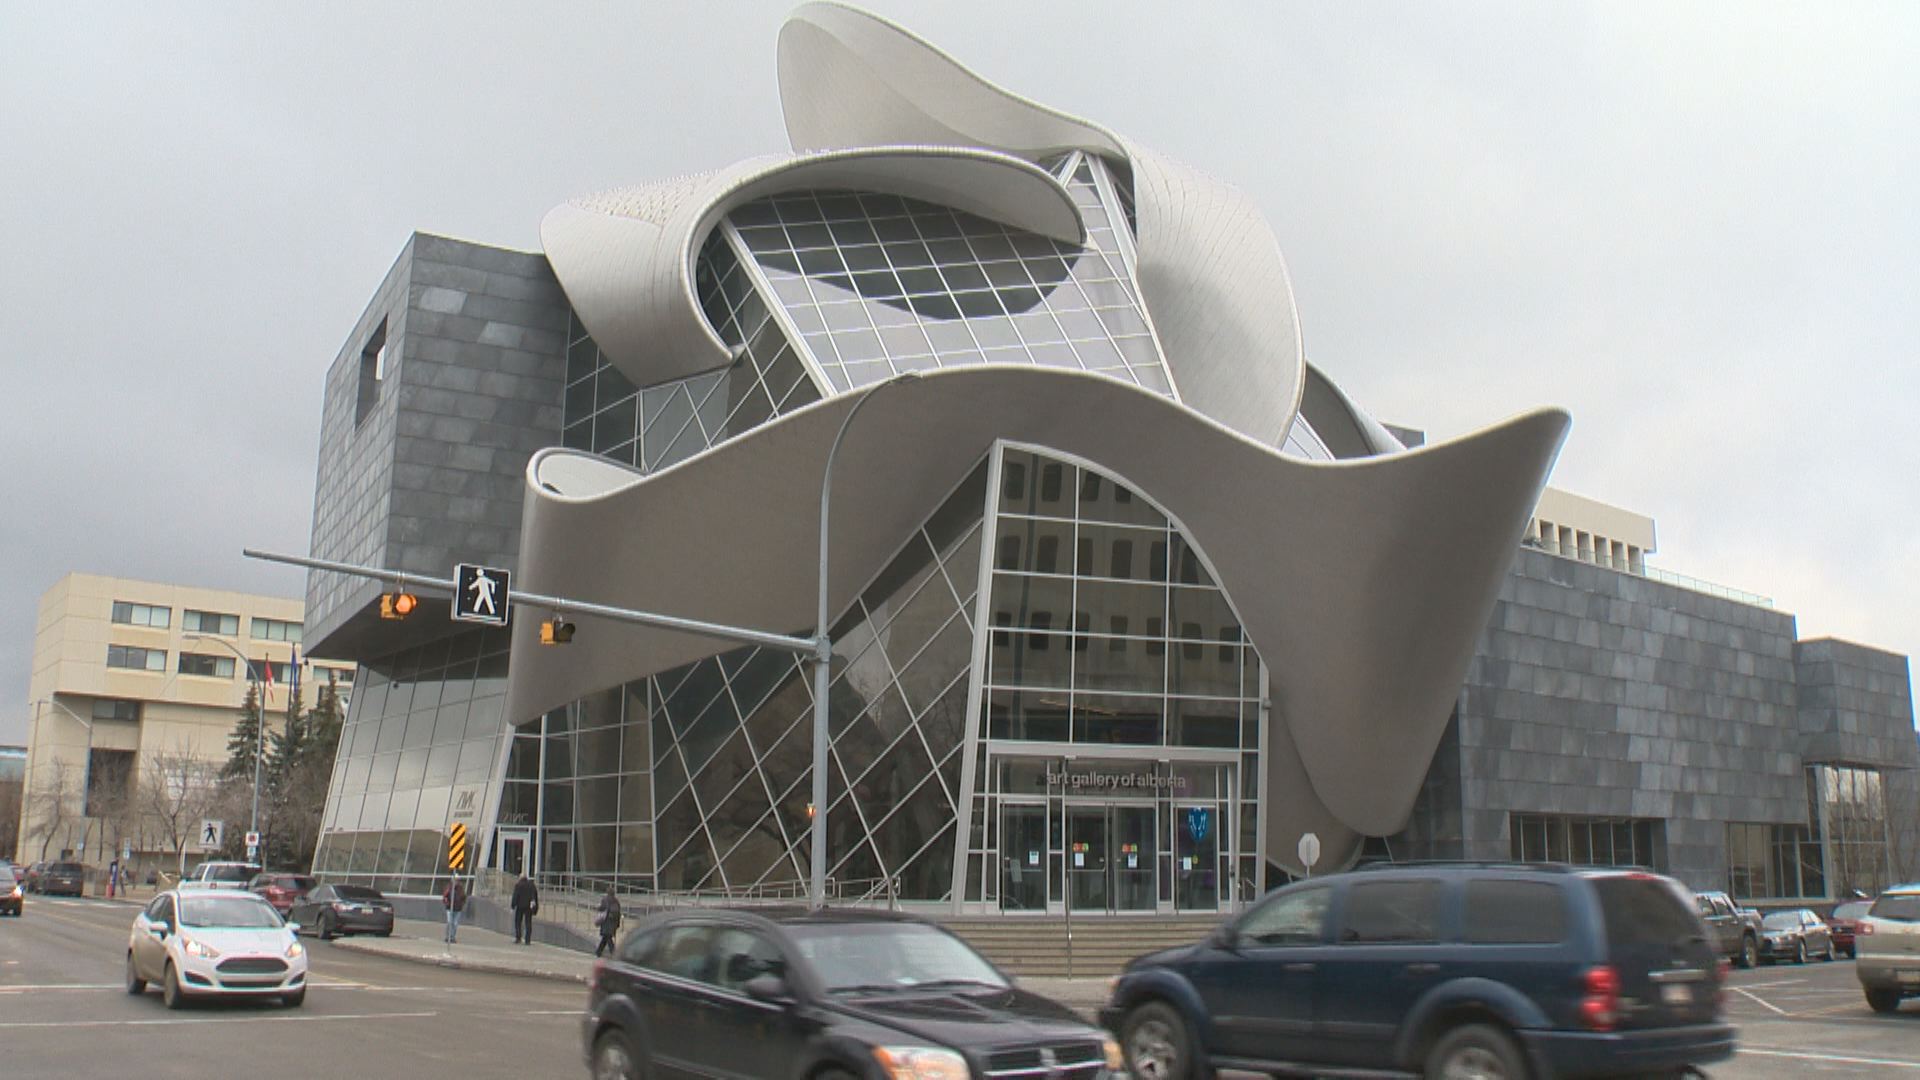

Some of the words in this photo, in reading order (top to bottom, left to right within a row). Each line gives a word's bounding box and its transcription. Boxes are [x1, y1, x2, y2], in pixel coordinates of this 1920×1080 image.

[1047, 771, 1068, 785] art
[1071, 770, 1119, 789] gallery
[1120, 772, 1134, 786] of
[1136, 772, 1186, 788] alberta
